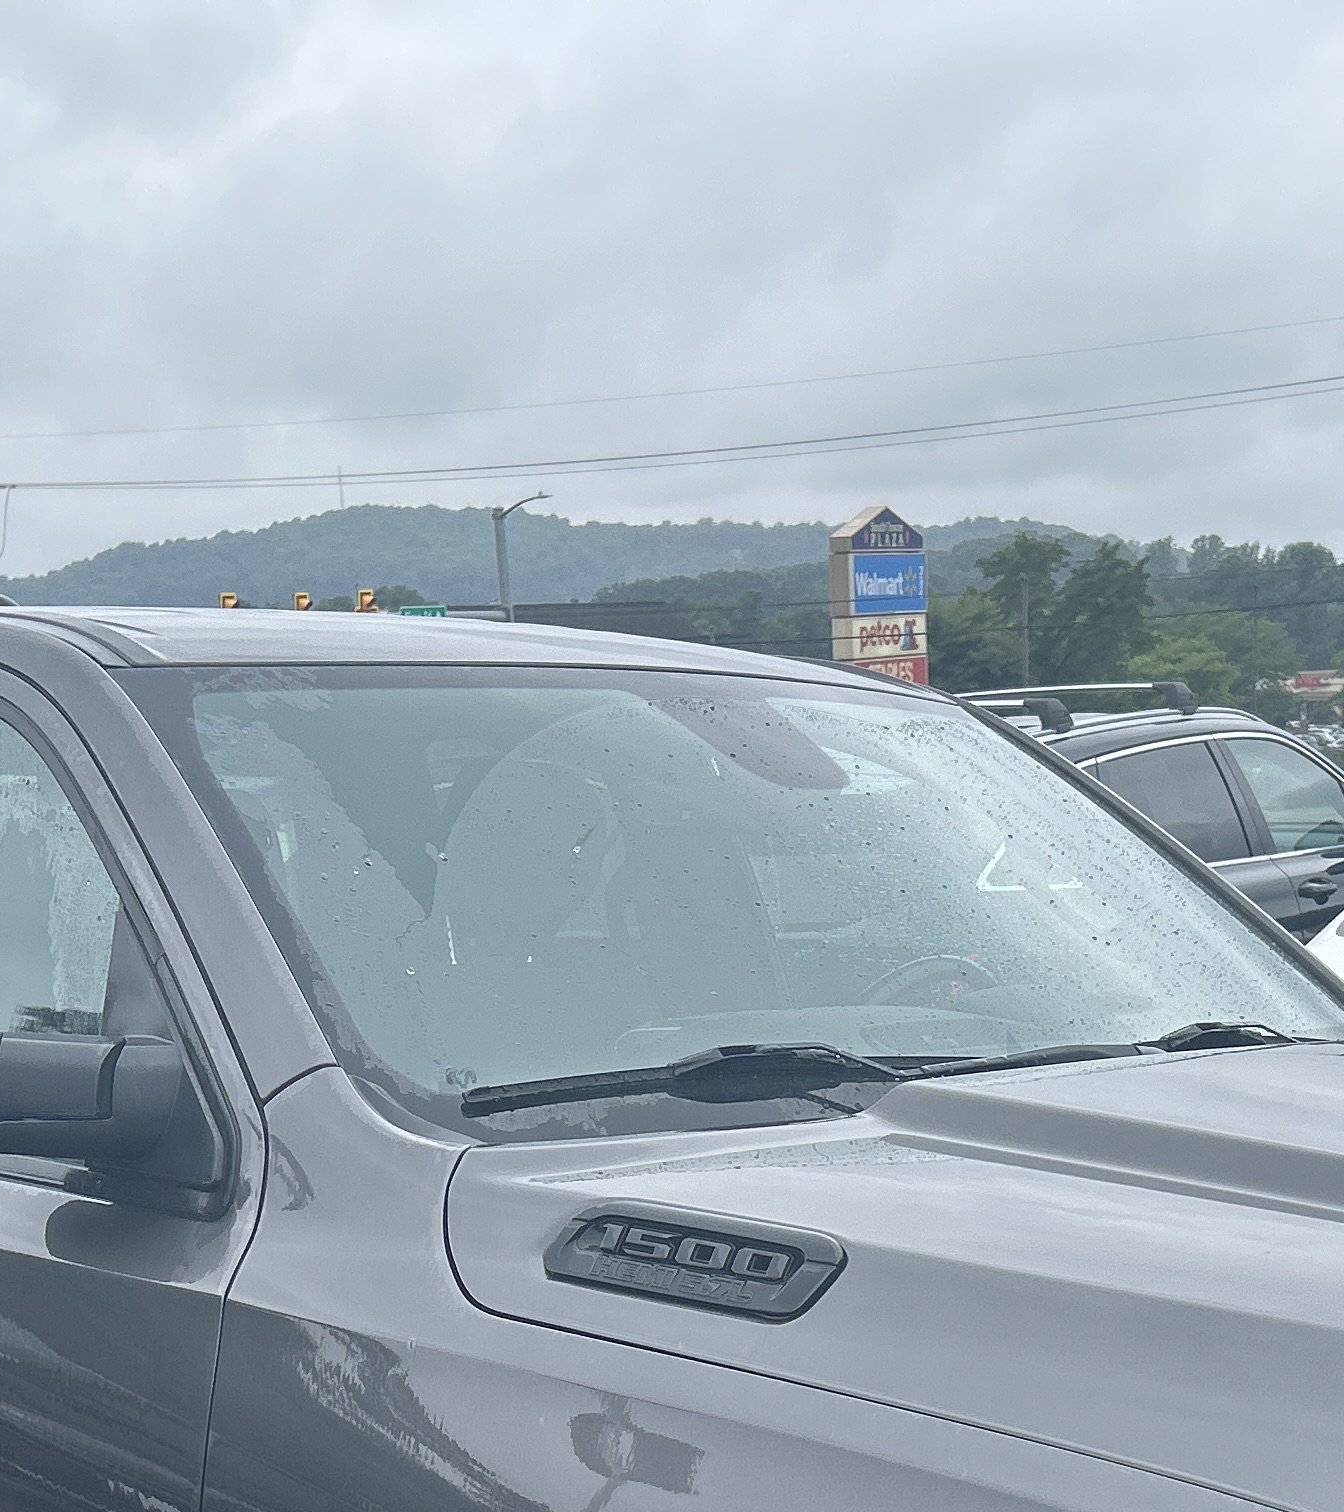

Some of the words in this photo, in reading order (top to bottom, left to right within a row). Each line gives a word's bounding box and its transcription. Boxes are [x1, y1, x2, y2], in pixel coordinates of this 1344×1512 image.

[856, 570, 904, 597] Walmart
[860, 621, 902, 654] petco
[577, 1222, 794, 1282] 1500
[588, 1253, 679, 1290] HEMI
